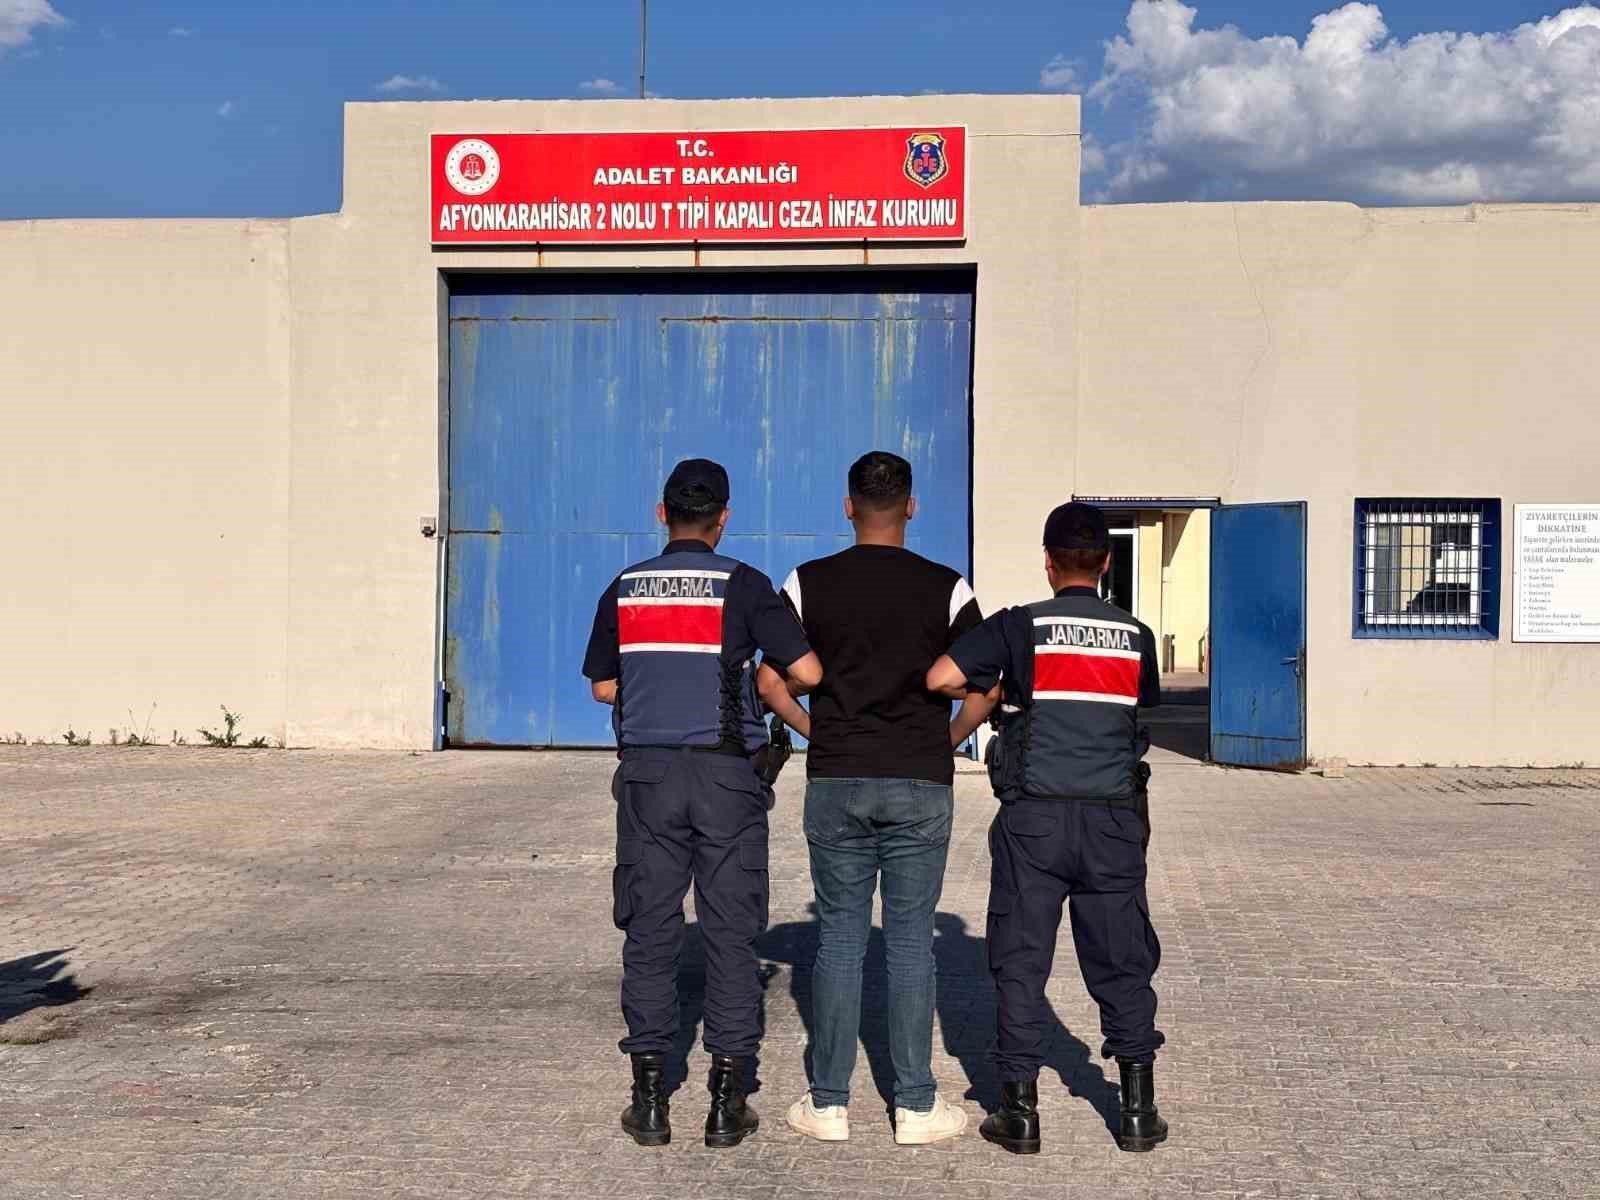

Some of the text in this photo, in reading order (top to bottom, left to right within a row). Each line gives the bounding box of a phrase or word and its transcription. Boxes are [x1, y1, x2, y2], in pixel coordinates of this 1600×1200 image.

[676, 139, 714, 157] T.C.
[593, 162, 798, 186] ADALET BAKANLIĞI
[439, 193, 959, 232] AFYONKARAHİSAR 2 NOLU T TİPİ KAPALI CEZA İNFAZ KURUMU
[629, 577, 715, 598] JANDARMA
[1046, 624, 1132, 650] JANDARMA
